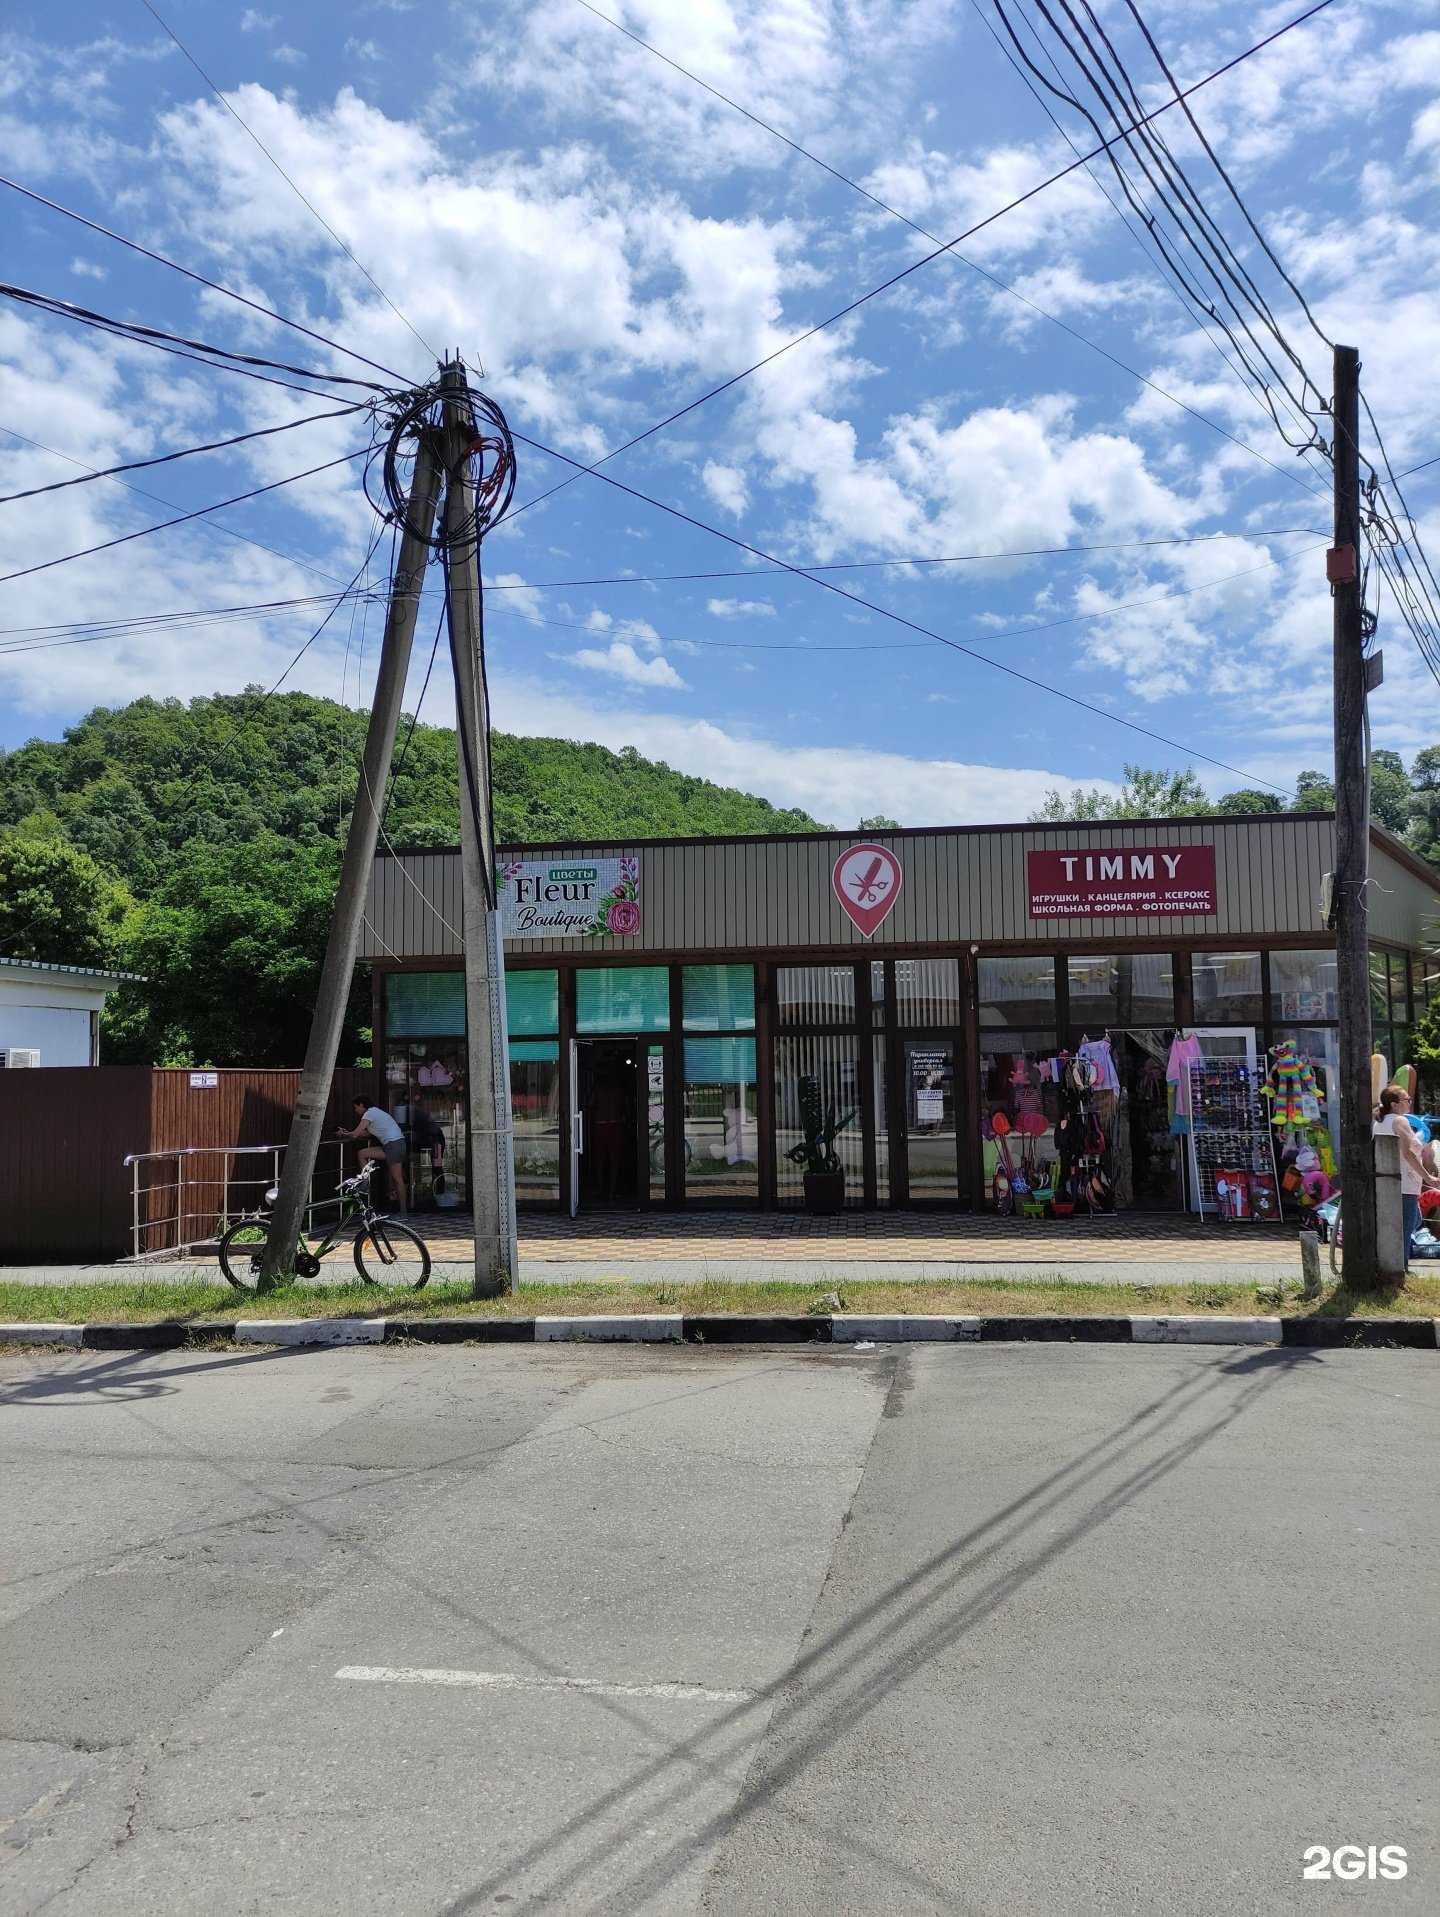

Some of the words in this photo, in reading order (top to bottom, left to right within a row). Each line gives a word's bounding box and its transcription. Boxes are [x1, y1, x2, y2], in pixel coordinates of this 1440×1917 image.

[1060, 854, 1183, 882] TIMMY
[514, 876, 596, 903] Fleur
[1032, 894, 1080, 903] ИГРУШКИ
[1088, 892, 1156, 902] КАНЦЕЛЯРИЯ
[1164, 890, 1211, 900] КСЕРОКС
[516, 906, 594, 933] Boutique
[1032, 904, 1091, 914] ШКОЛЬНАЯ
[1094, 903, 1134, 913] ФОРМА
[1142, 901, 1211, 911] ФОТОПЕЧАТЬ
